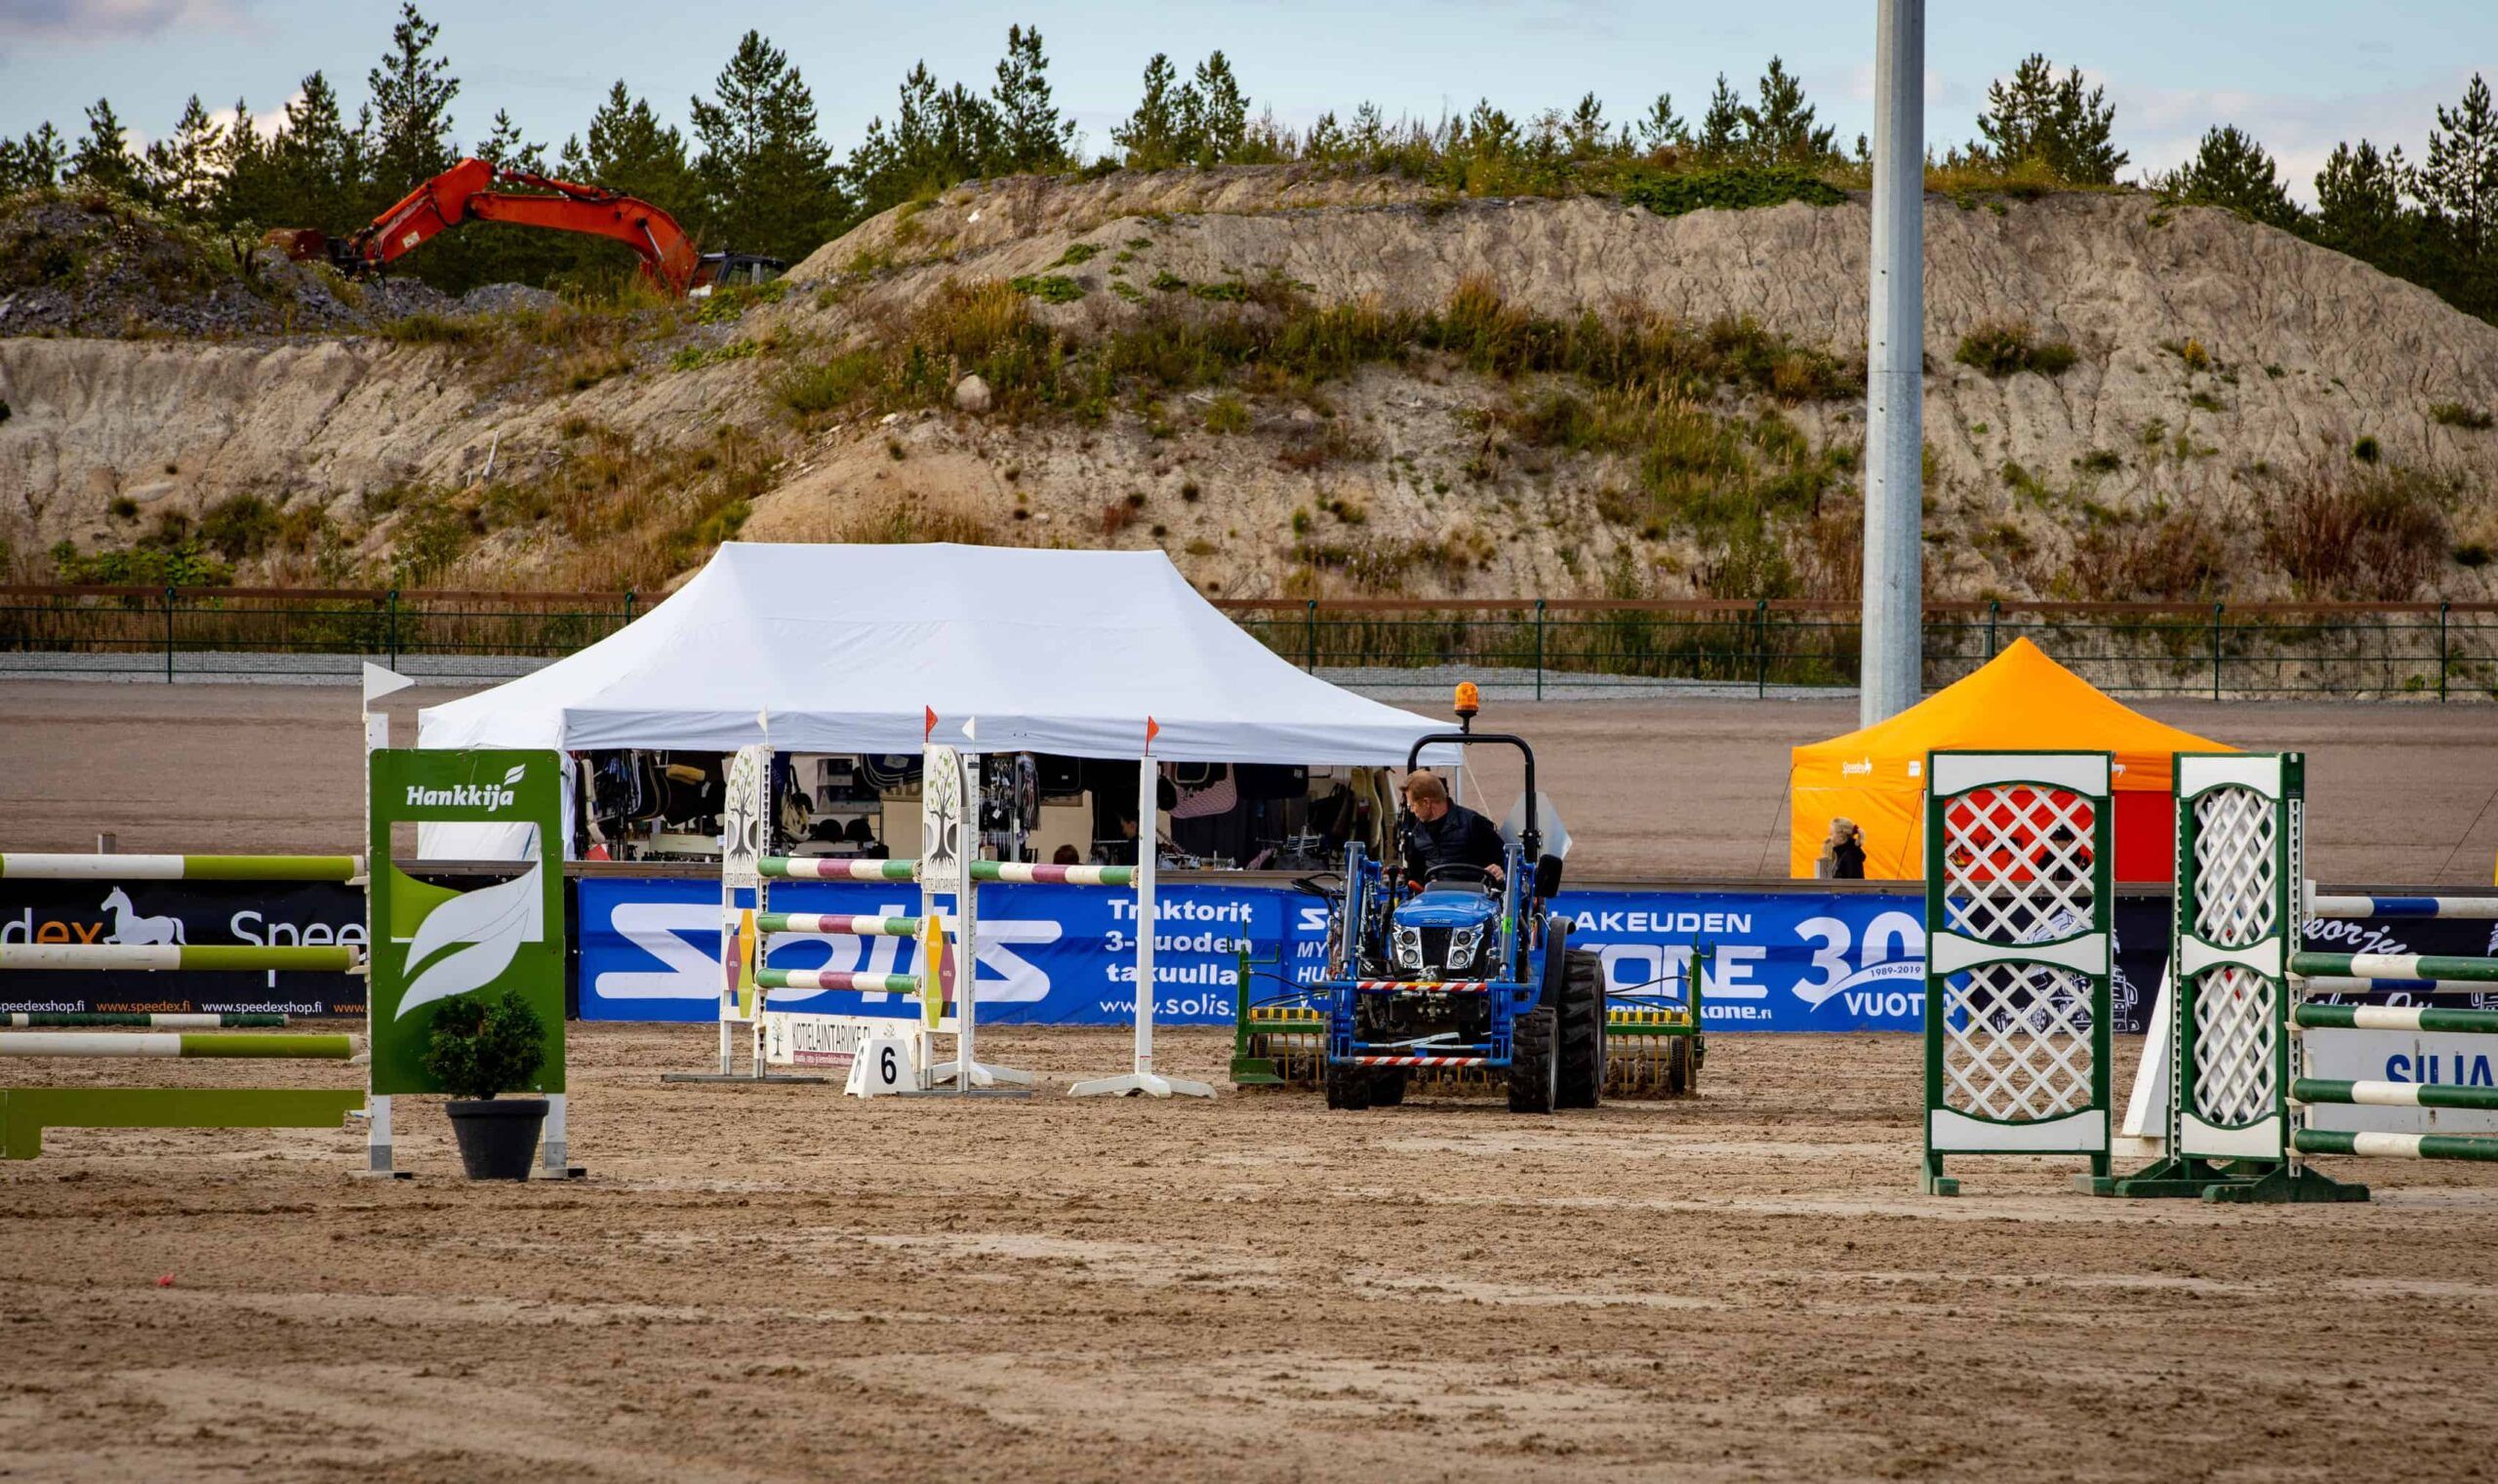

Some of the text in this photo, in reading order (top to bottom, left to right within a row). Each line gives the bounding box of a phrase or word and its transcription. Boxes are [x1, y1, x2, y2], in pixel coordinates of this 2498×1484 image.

[406, 783, 514, 812] Hankkija
[1551, 911, 1752, 934] AKEUDEN
[1105, 930, 1253, 954] 3-uoden
[1792, 910, 1926, 1004] 30
[1579, 943, 1769, 999] ONE
[1871, 965, 1921, 978] 1989-2019
[97, 1000, 190, 1014] www.speedex.fi
[202, 1001, 322, 1016] www.speedexshop.fi
[1100, 992, 1236, 1017] ww.solis.
[1843, 991, 1955, 1017] VUOT
[881, 1046, 898, 1085] 6
